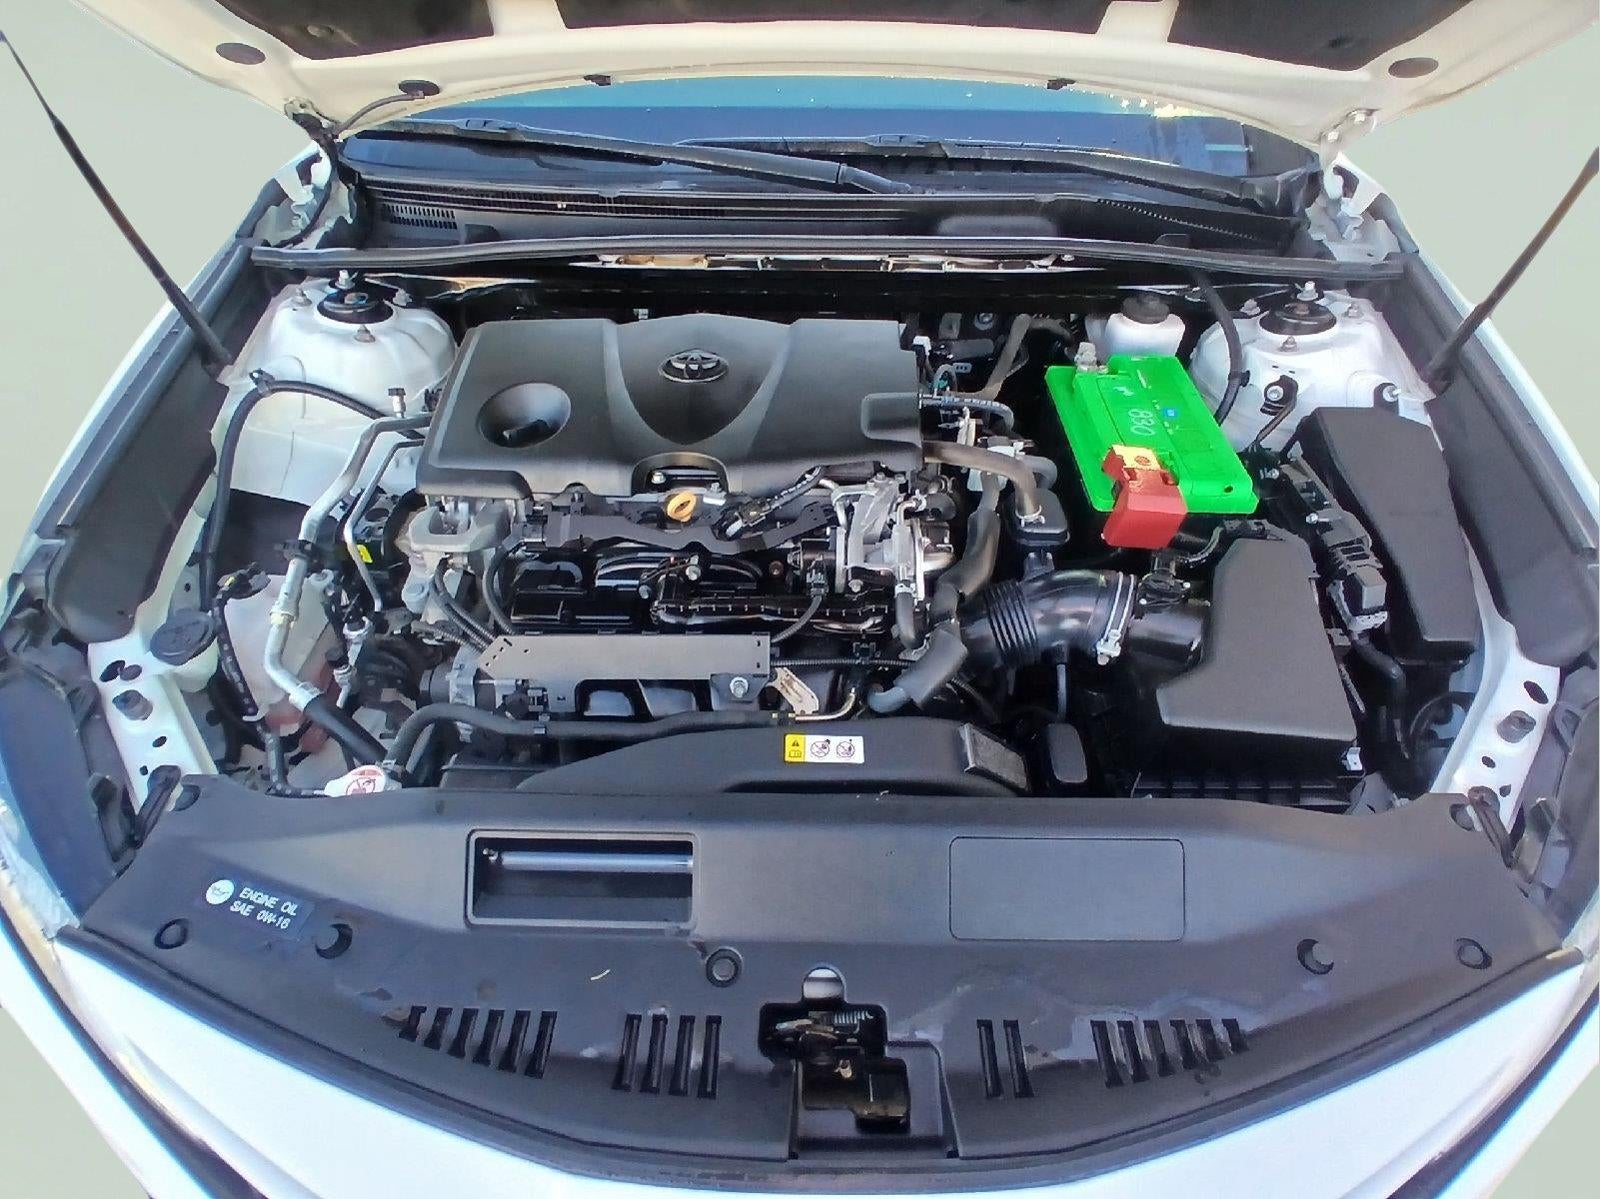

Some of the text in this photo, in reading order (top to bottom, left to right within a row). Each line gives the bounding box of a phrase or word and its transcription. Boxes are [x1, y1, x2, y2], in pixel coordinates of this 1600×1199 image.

[1128, 409, 1155, 436] 830
[230, 900, 255, 916] SAE
[240, 887, 298, 916] ENGINE OIL
